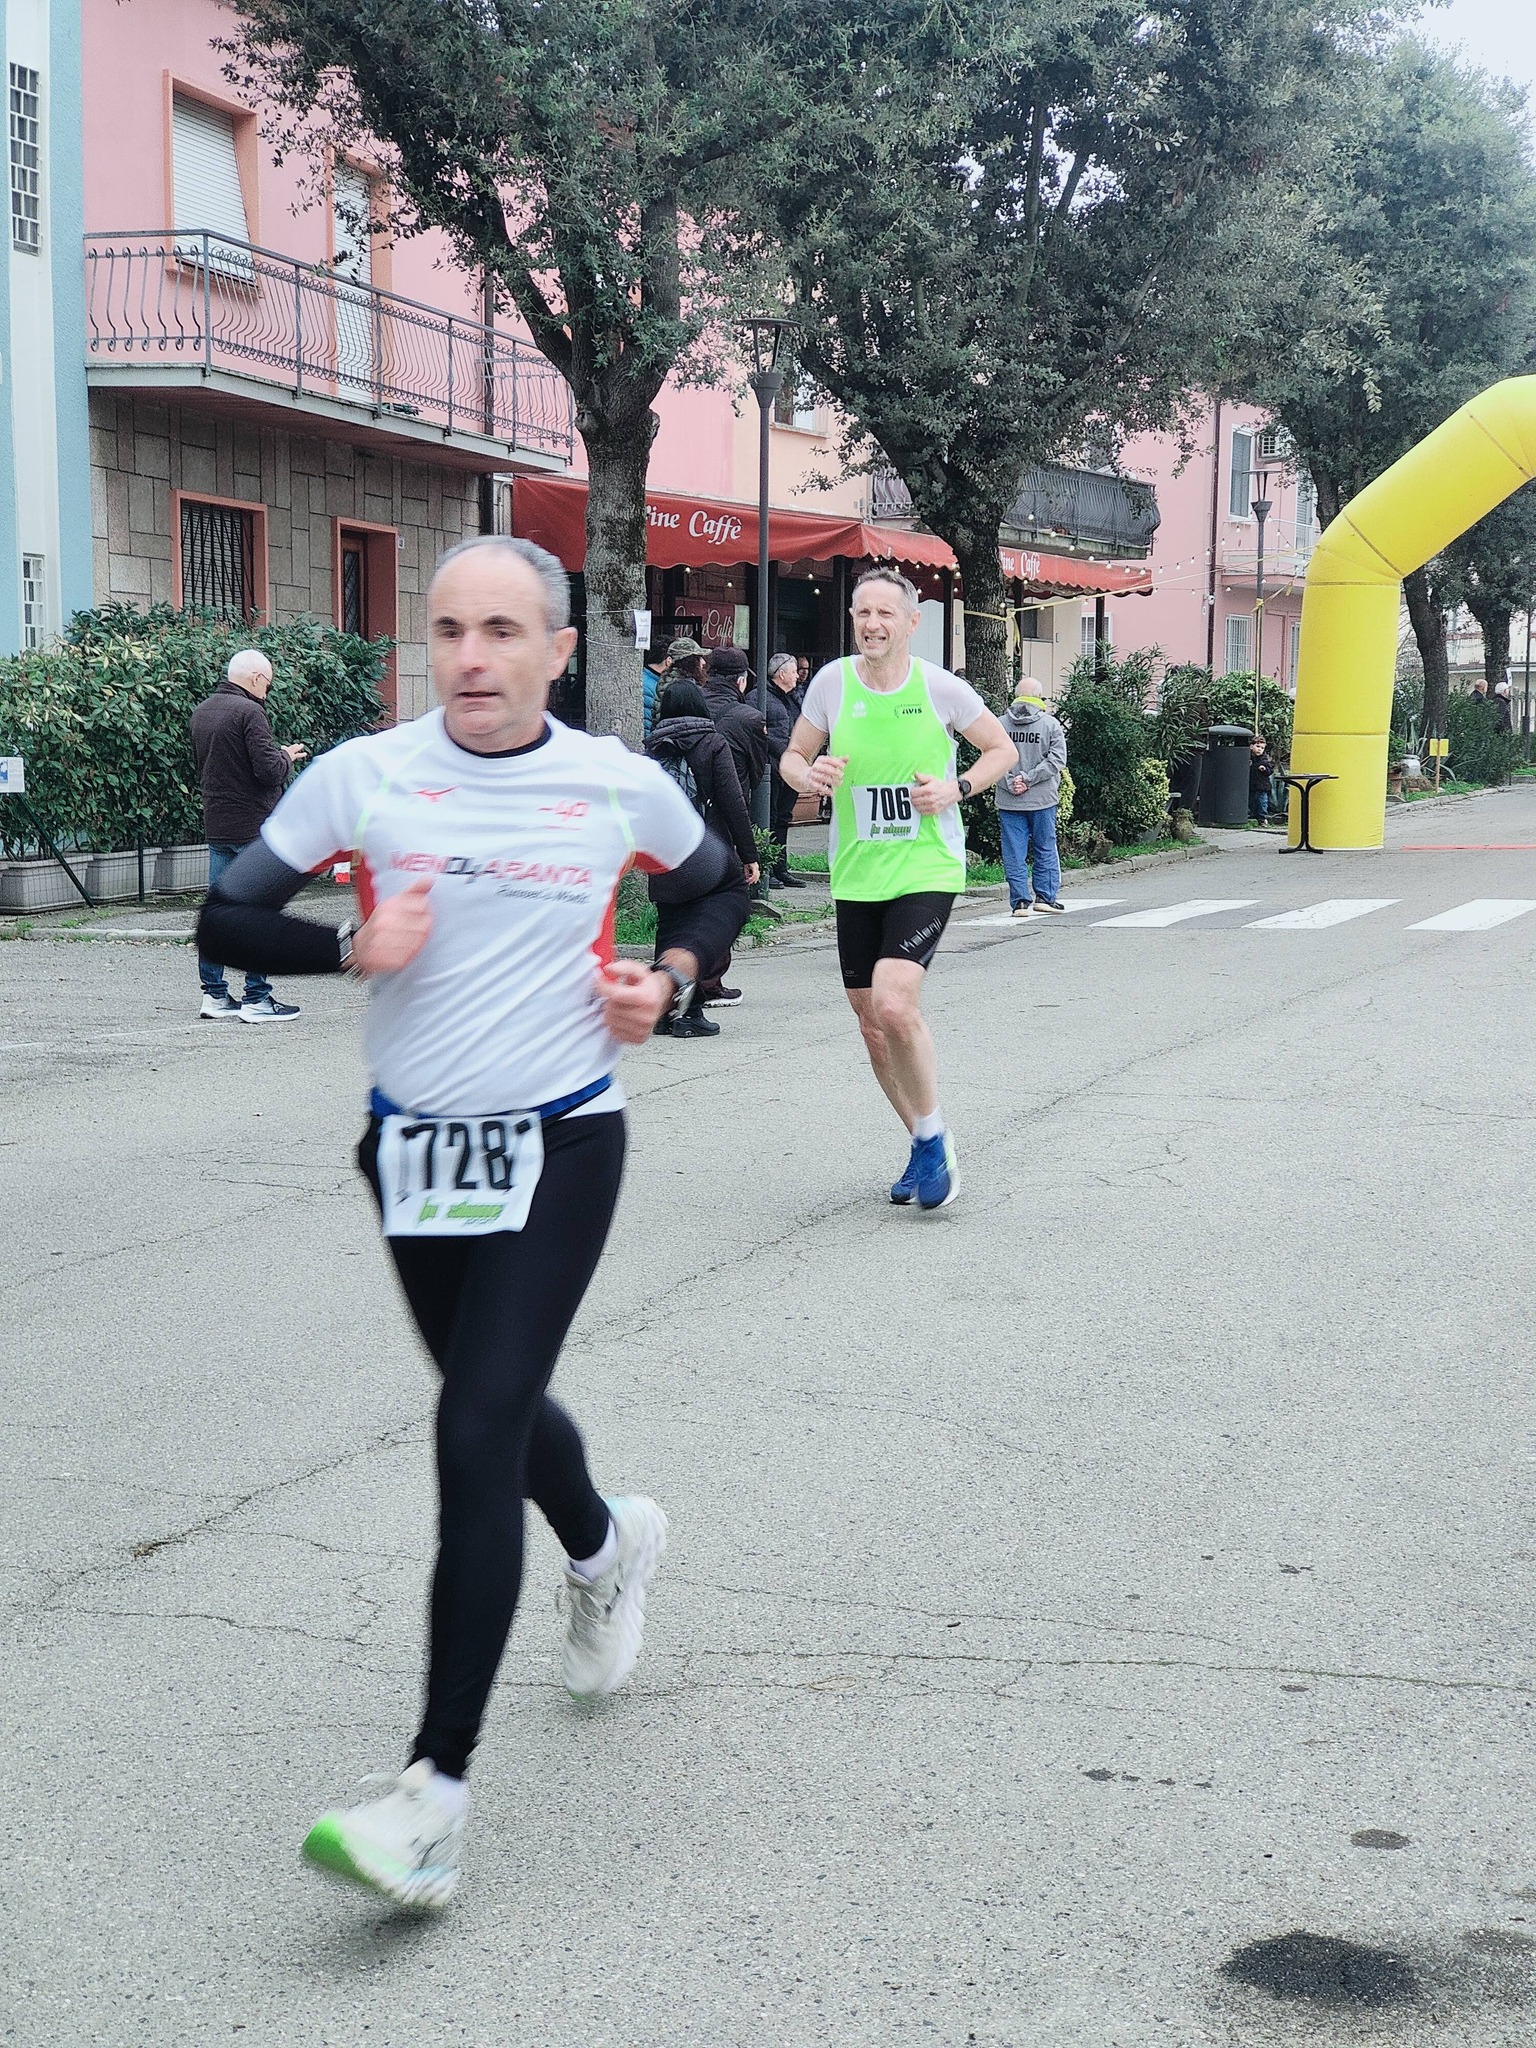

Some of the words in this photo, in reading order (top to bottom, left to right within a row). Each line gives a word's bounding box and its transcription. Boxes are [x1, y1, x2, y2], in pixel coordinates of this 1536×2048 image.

[689, 510, 742, 545] Caffè
[1000, 551, 1015, 571] ine
[1021, 552, 1040, 581] Caffè
[866, 787, 912, 821] 706
[401, 1120, 513, 1191] 728
